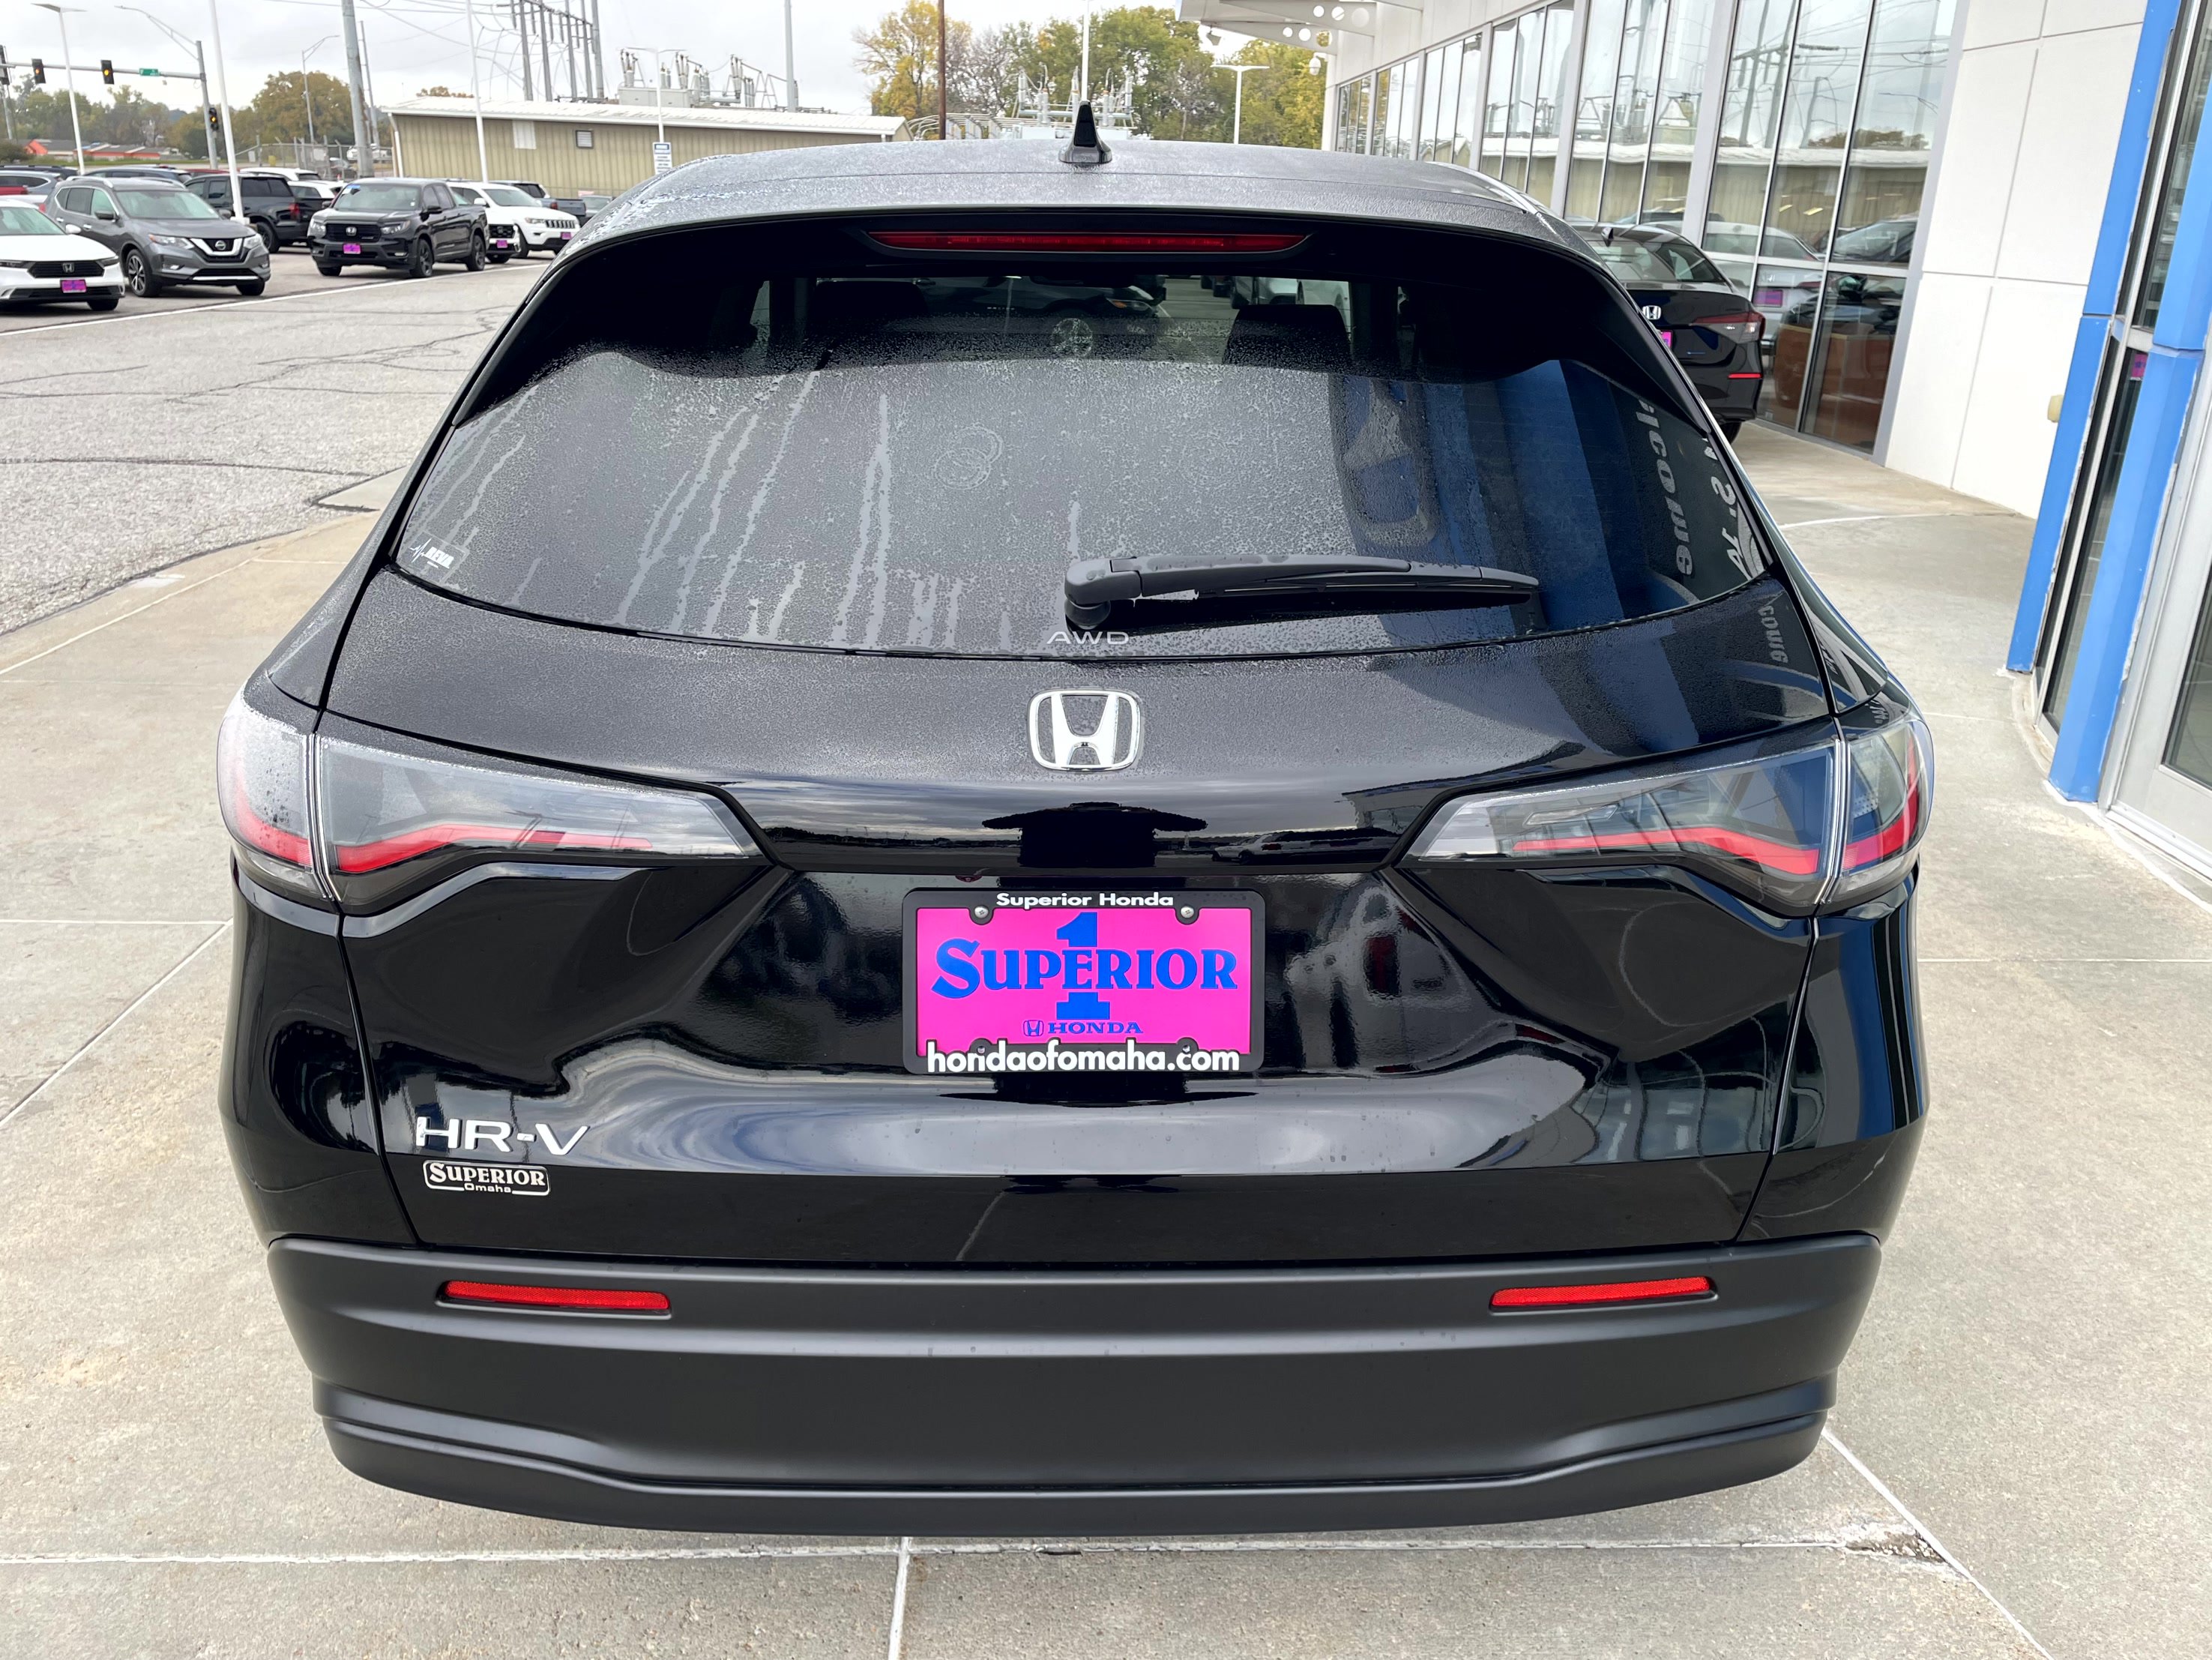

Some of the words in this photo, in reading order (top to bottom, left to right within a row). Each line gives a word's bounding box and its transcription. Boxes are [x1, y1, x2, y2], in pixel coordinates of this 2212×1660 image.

[424, 547, 454, 568] REVA
[1046, 631, 1129, 645] AWD
[996, 892, 1091, 909] Superior
[1099, 893, 1174, 906] Honda
[931, 938, 1238, 999] SUPERIOR
[1048, 1021, 1143, 1034] HONDA
[927, 1039, 1240, 1073] hondaofomaha.com
[416, 1116, 590, 1155] HR-V
[430, 1162, 546, 1186] SUPERIOR
[464, 1182, 511, 1193] Omaha
